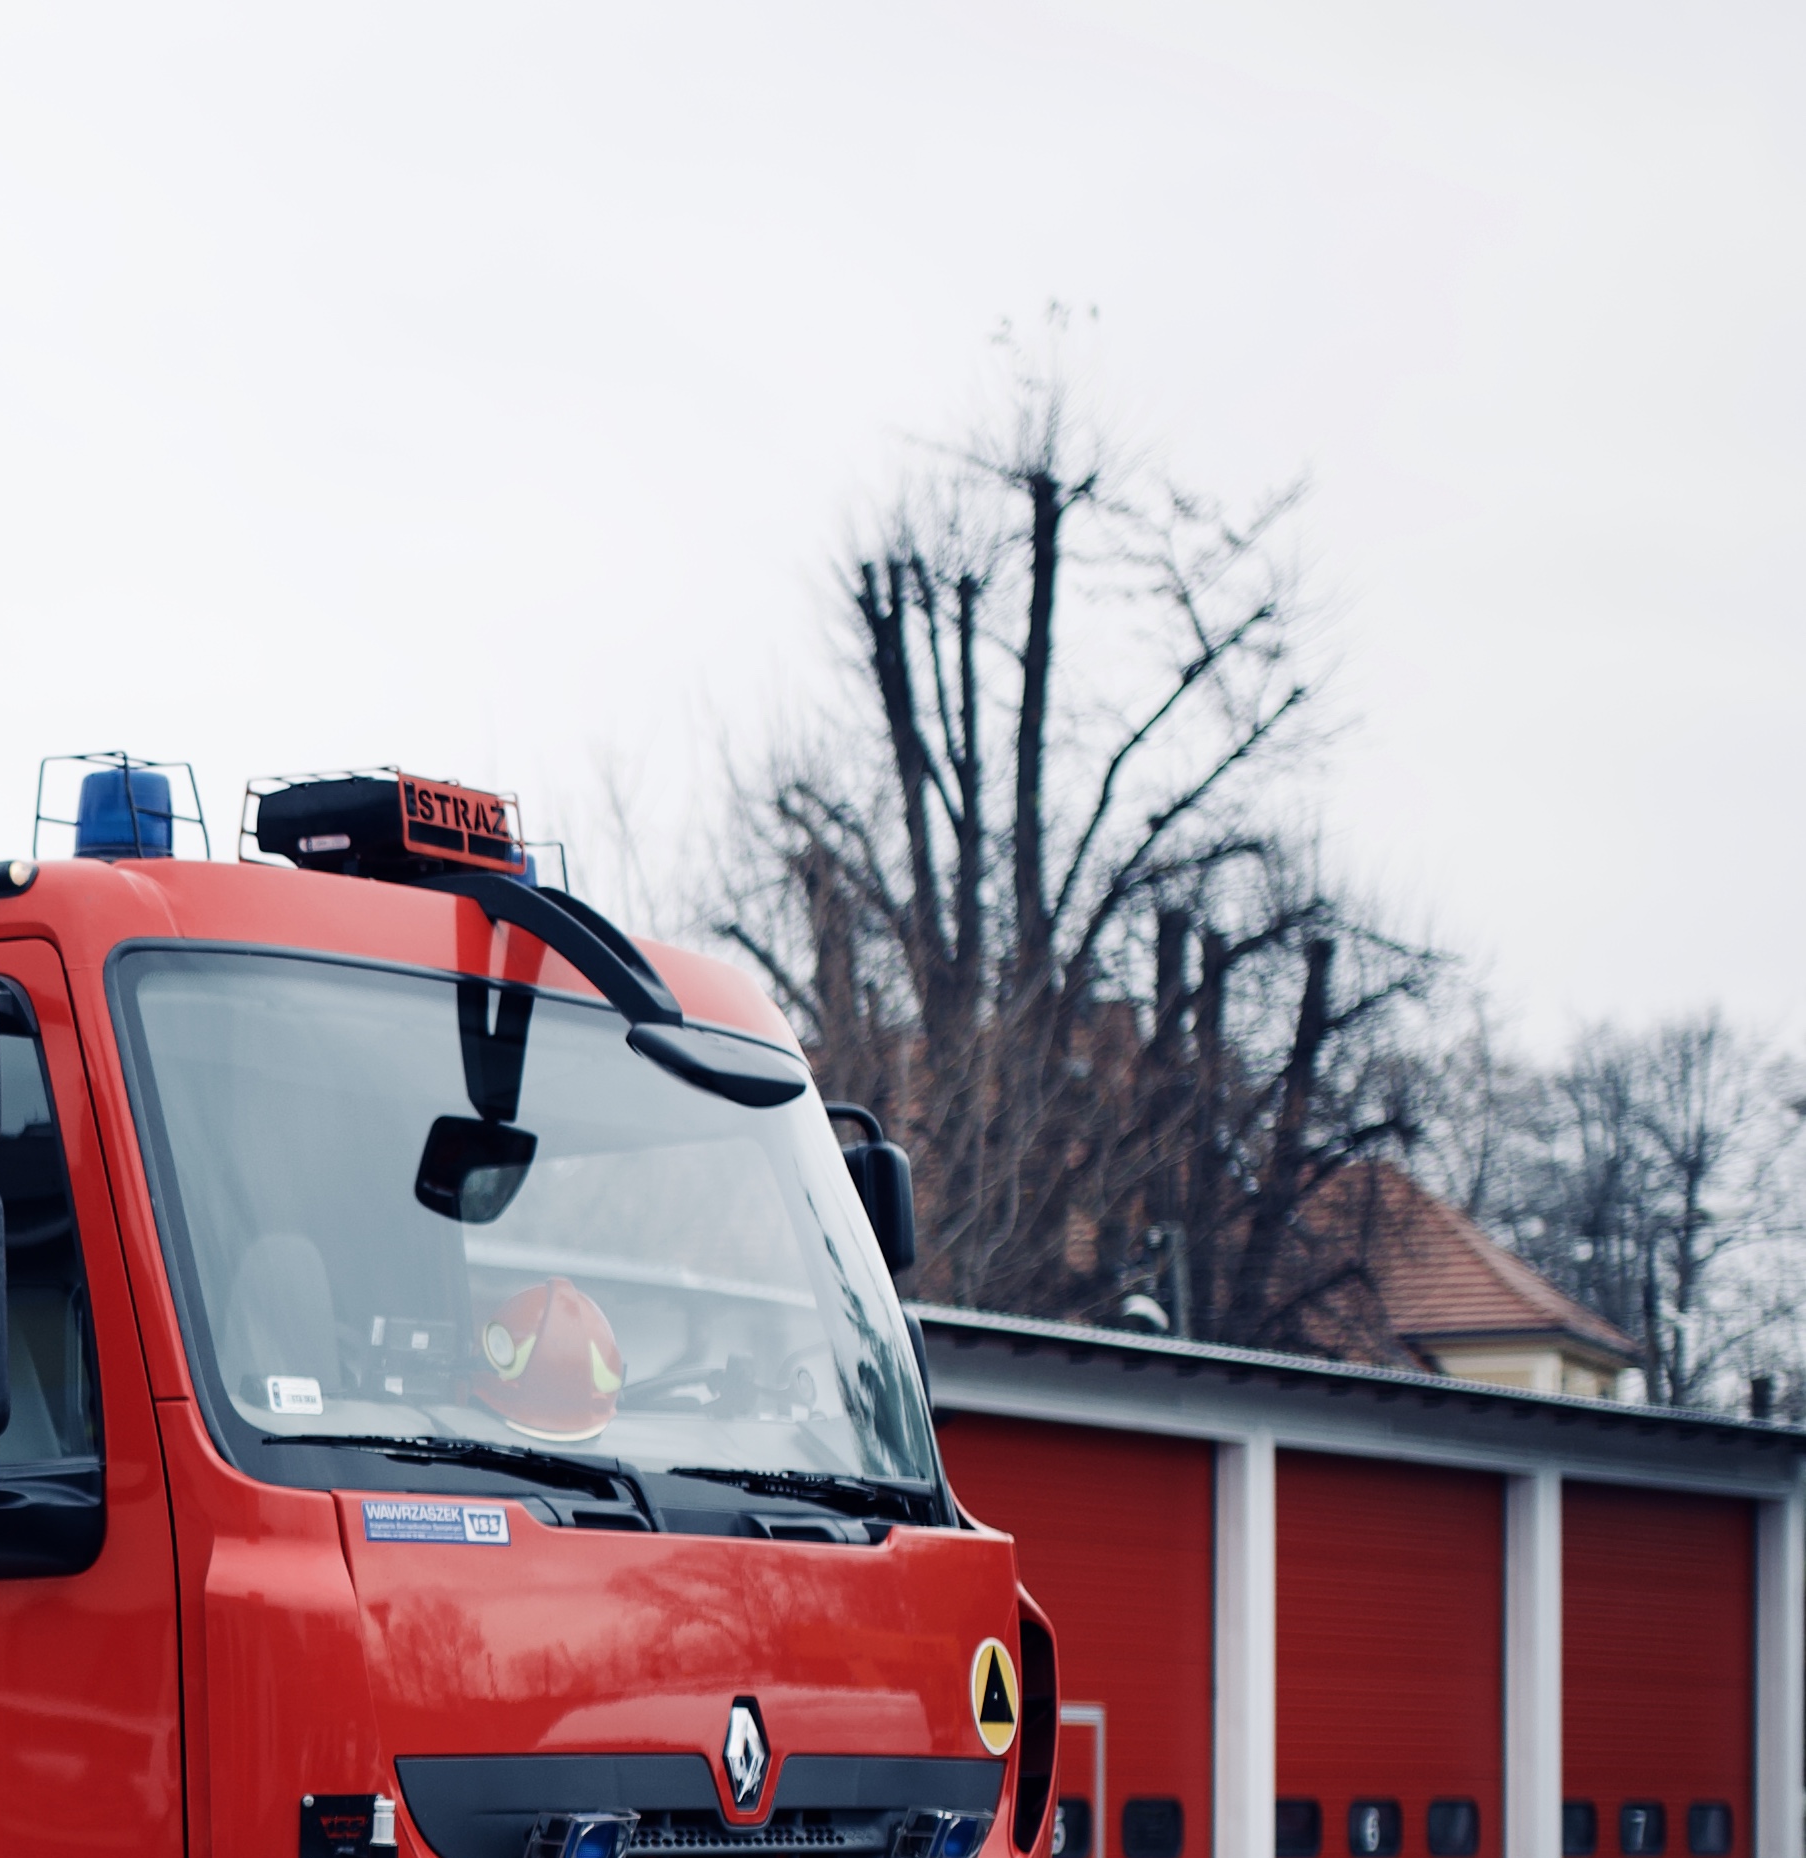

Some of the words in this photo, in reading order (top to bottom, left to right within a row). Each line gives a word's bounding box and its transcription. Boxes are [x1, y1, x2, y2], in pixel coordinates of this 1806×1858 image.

[418, 789, 509, 838] STRAŻ
[364, 1503, 461, 1522] WAWRZASZEK
[1364, 1806, 1380, 1852] 6
[1630, 1809, 1647, 1850] 7
